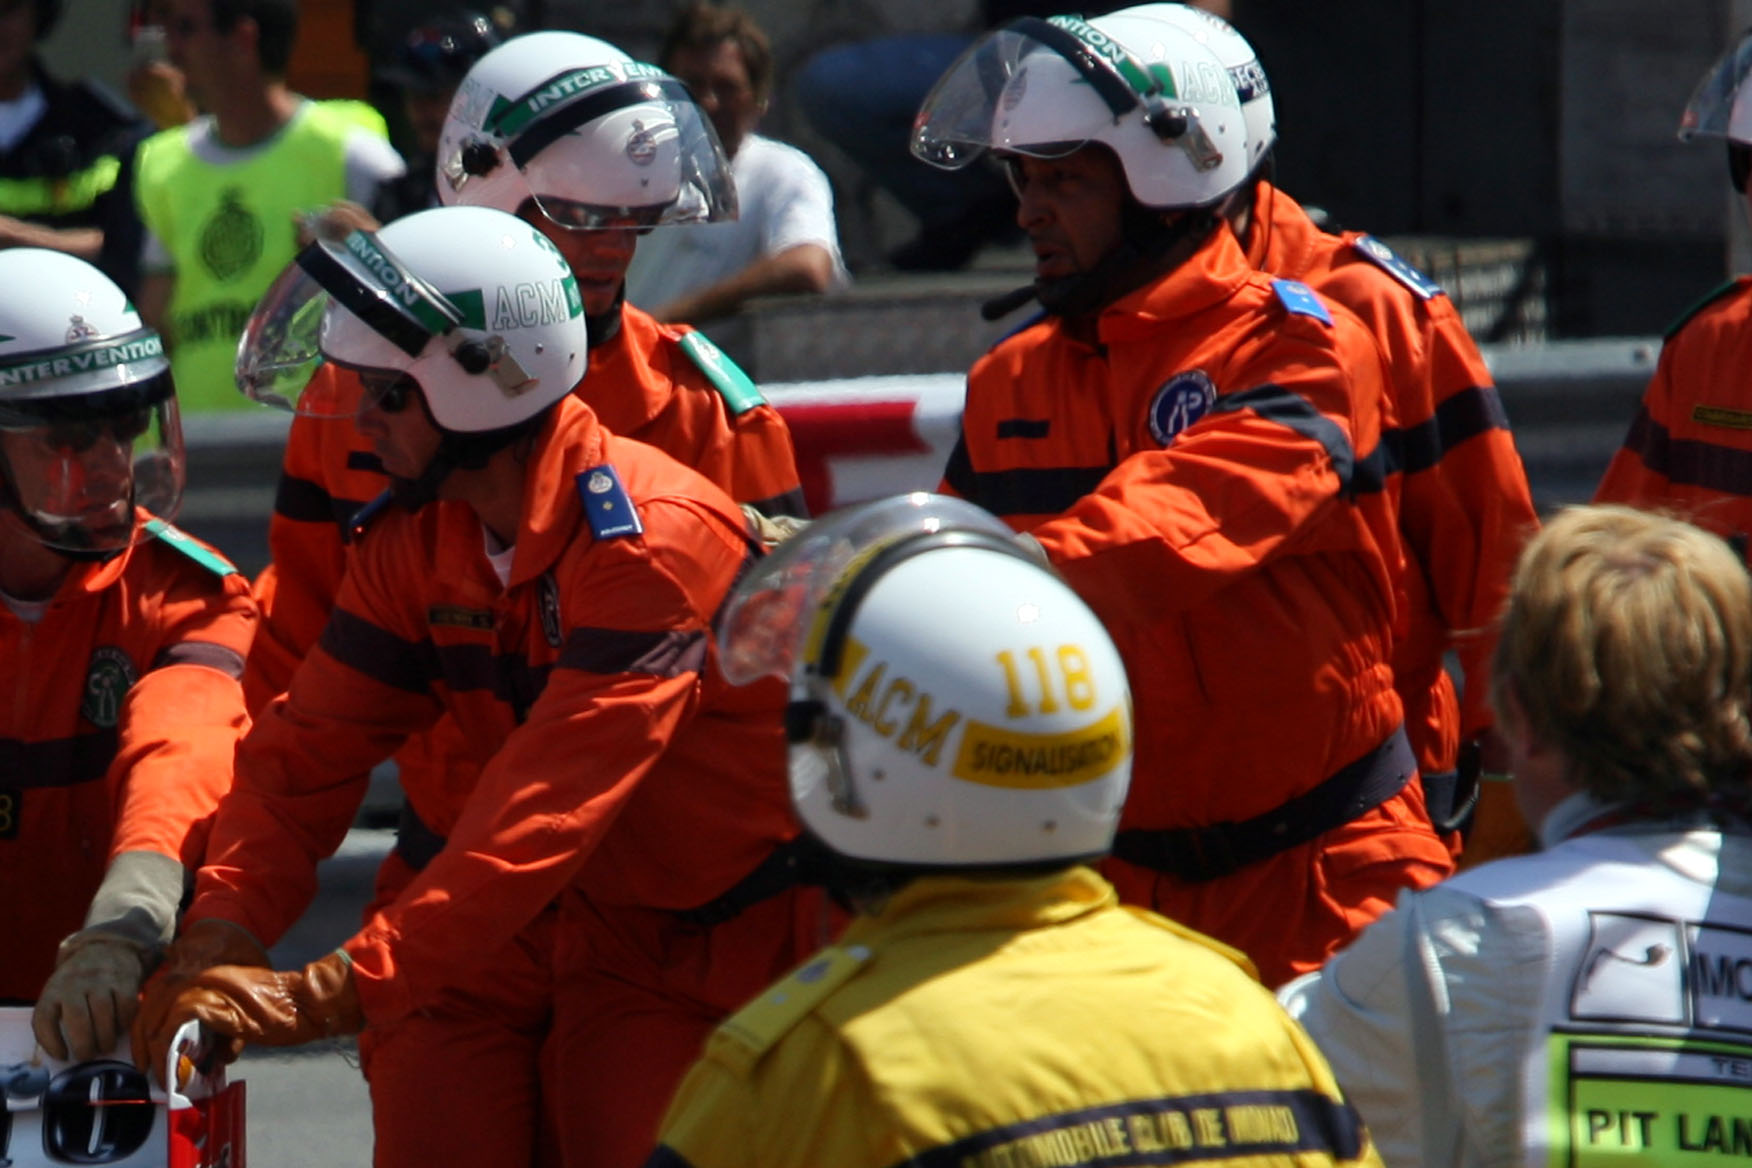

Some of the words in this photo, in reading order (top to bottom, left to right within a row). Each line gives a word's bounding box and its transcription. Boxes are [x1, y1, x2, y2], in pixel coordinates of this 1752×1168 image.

[493, 279, 566, 331] ACM
[996, 644, 1096, 719] 118
[845, 661, 963, 767] ACM
[1587, 1109, 1659, 1148] PIT
